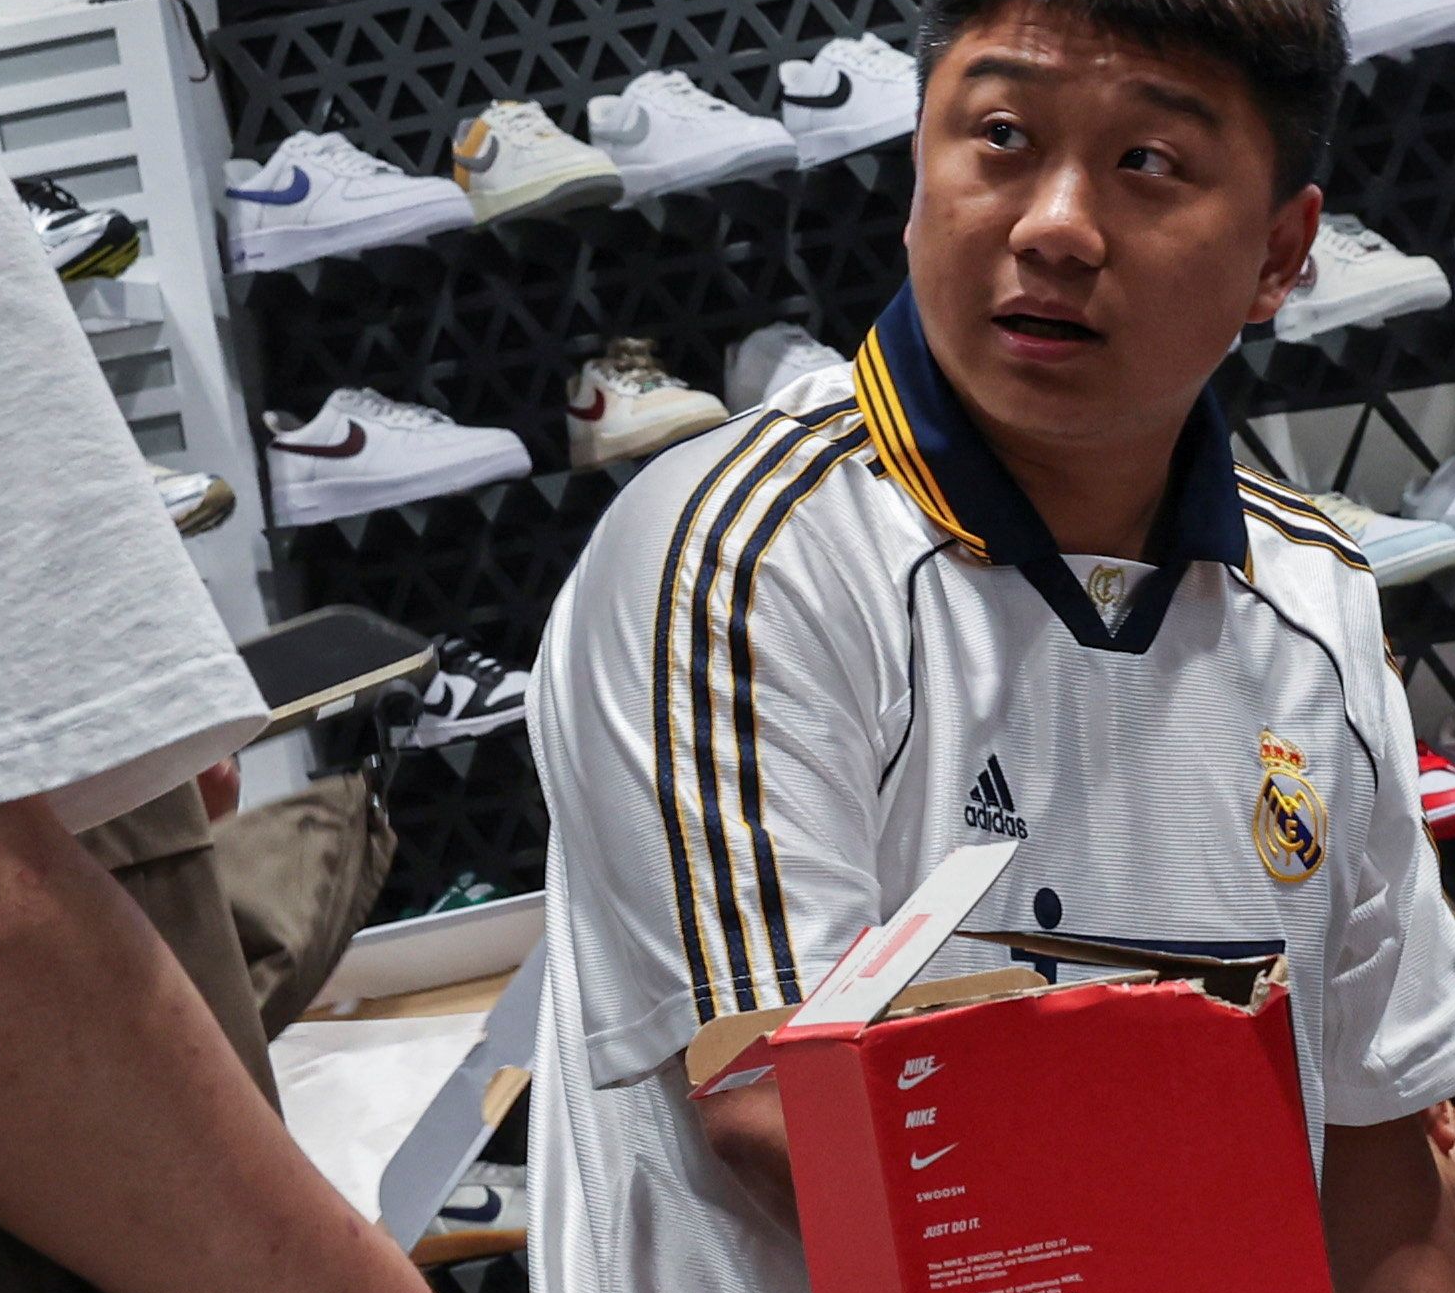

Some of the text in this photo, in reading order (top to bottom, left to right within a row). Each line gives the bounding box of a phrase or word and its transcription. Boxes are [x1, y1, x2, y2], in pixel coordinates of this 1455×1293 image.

[964, 802, 1028, 839] adidas
[904, 1056, 936, 1077] NIKE
[905, 1106, 937, 1129] NIKE
[916, 1185, 966, 1203] SWOOSH
[923, 1222, 949, 1239] JUST
[951, 1219, 967, 1233] DO
